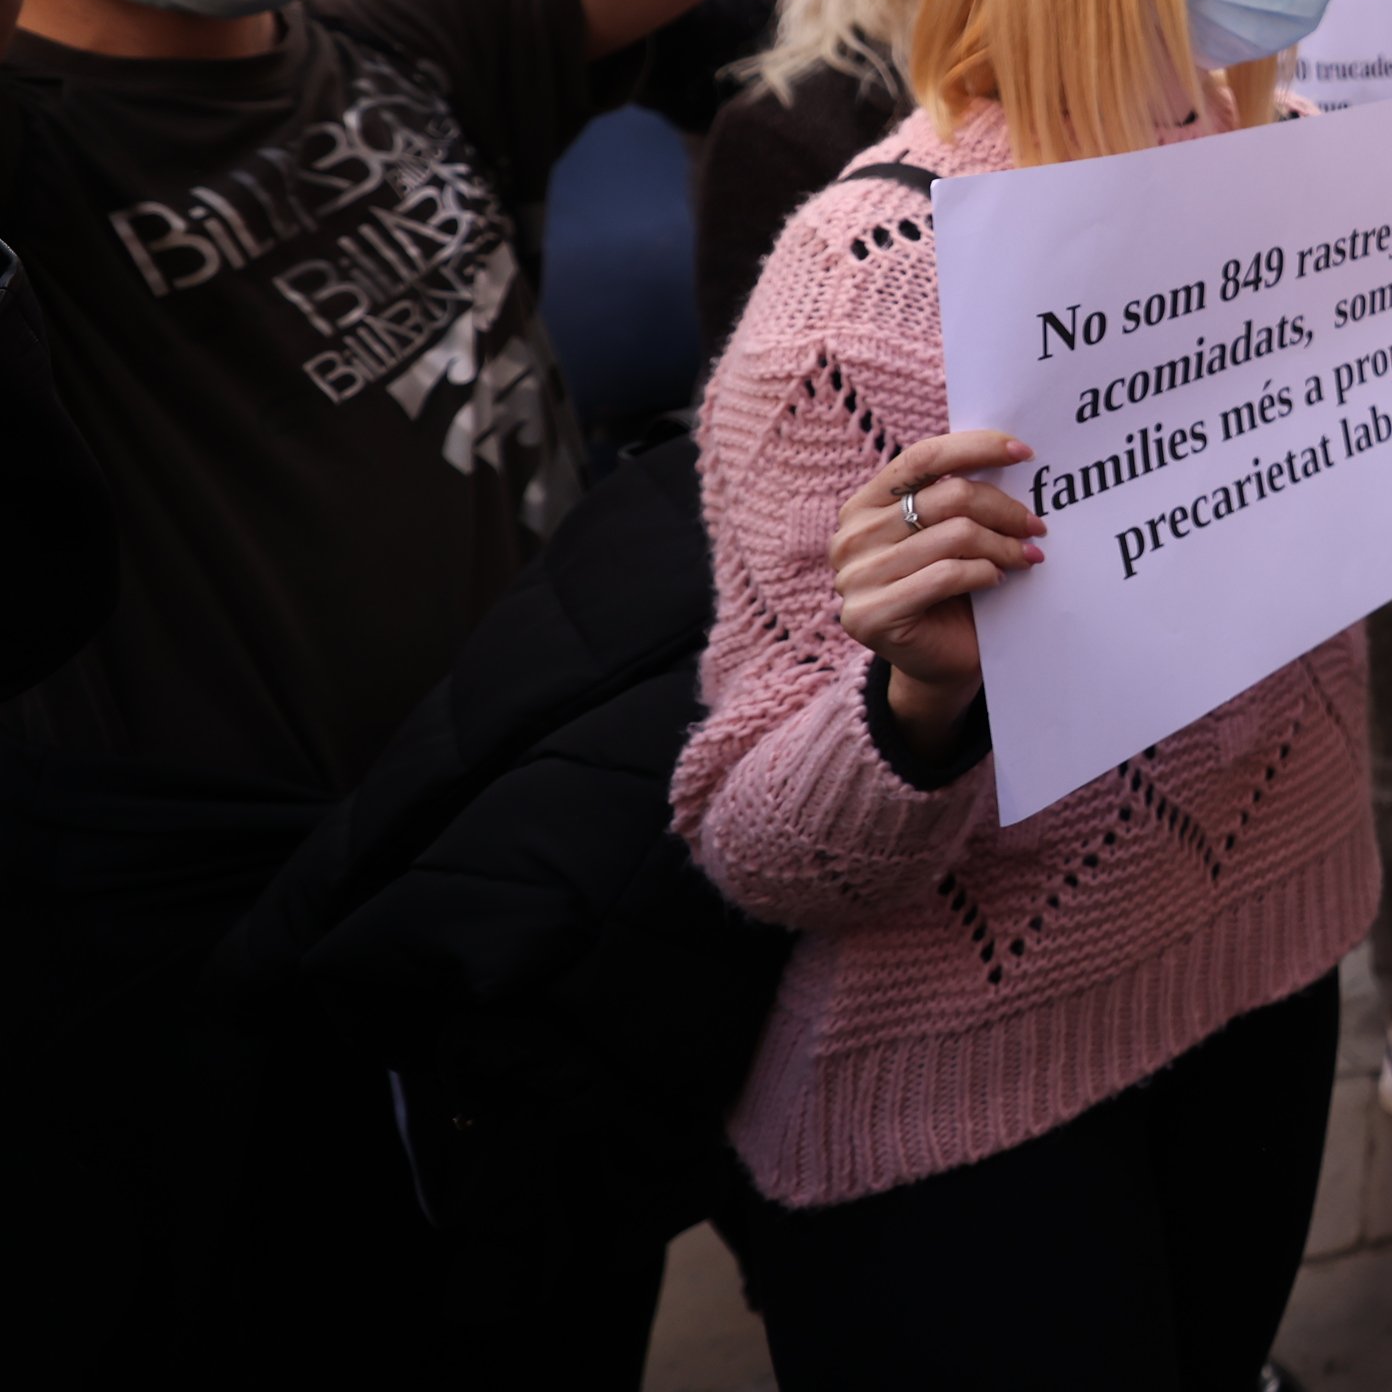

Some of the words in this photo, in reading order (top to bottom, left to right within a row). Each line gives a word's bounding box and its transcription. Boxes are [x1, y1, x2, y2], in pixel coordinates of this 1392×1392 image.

[1035, 303, 1108, 361] No
[1120, 276, 1207, 335] som
[1219, 244, 1285, 304] 849
[1073, 313, 1316, 424] acomiadats,
[1027, 412, 1210, 517] families
[1219, 382, 1295, 443] més
[1303, 371, 1326, 407] a
[1113, 429, 1337, 579] precarietat
